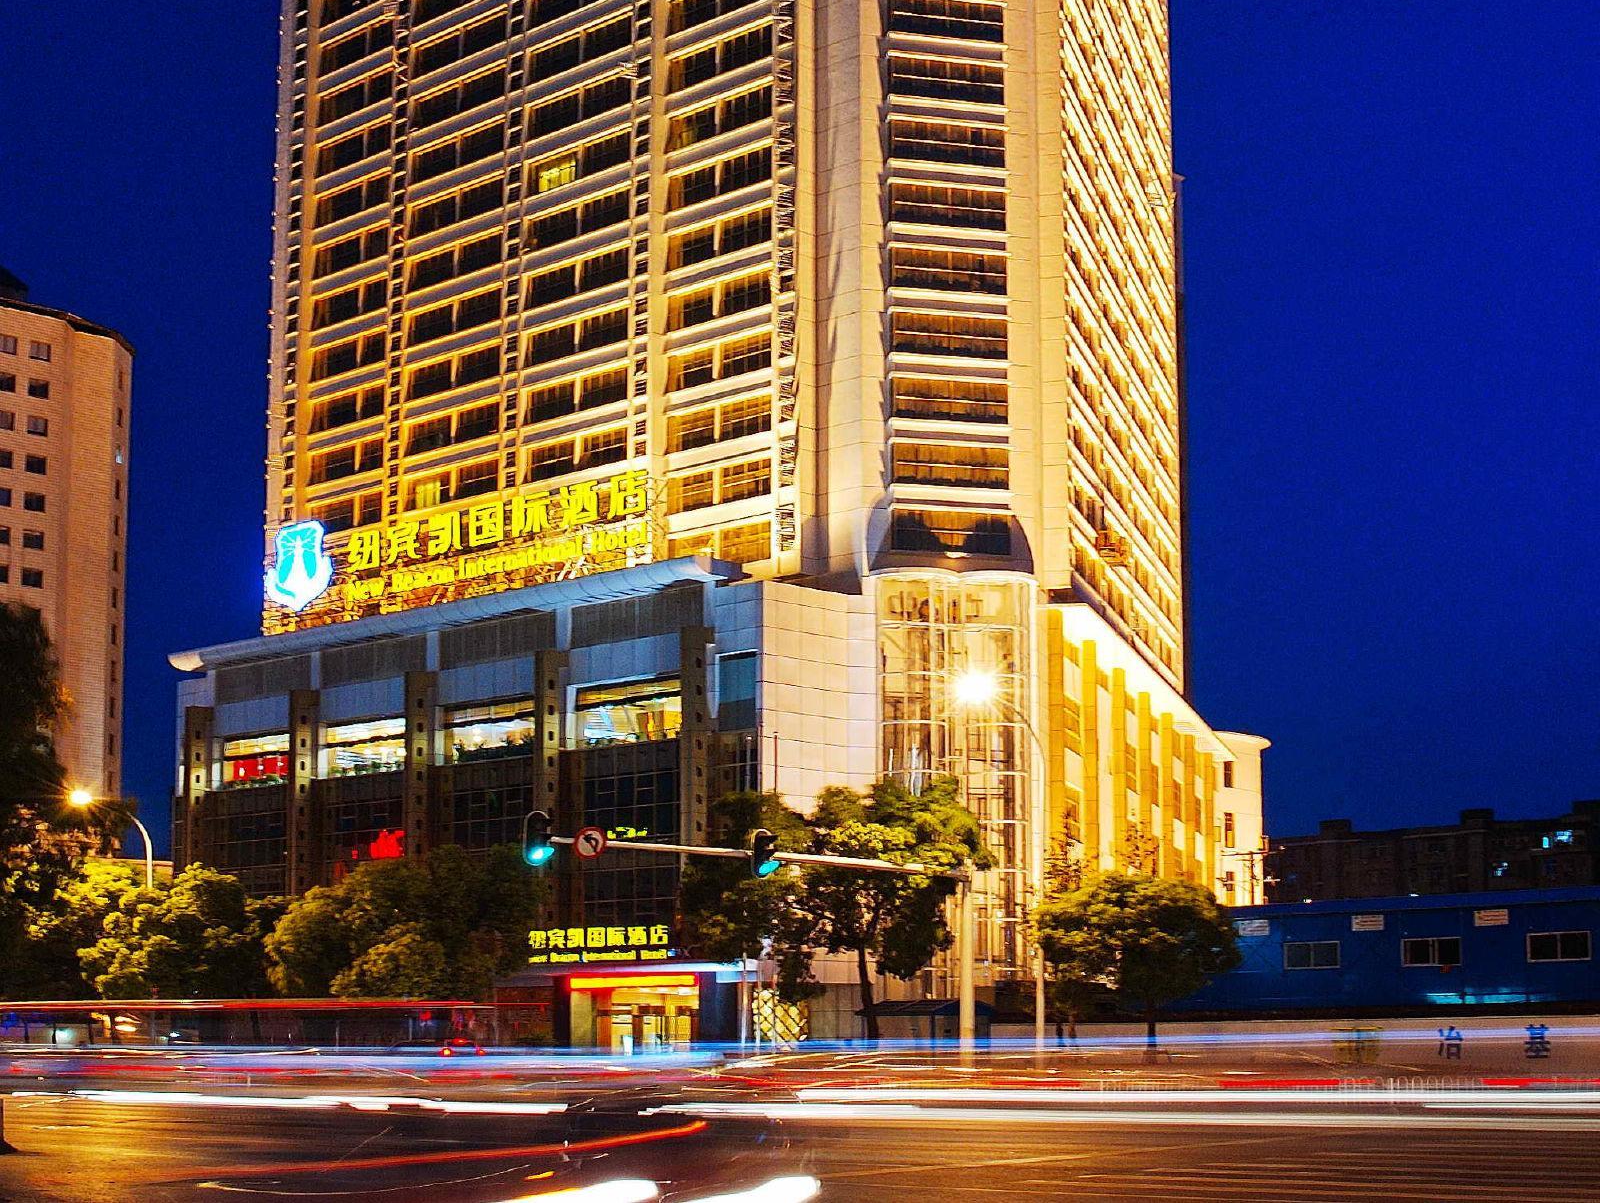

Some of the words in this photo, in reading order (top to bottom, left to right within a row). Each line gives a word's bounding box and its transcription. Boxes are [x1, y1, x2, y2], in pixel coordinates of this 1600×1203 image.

[344, 577, 386, 603] New
[391, 566, 455, 594] Beacon
[458, 534, 585, 580] International
[589, 521, 649, 554] Hotel
[346, 469, 649, 574] 纽宾凯国际酒店
